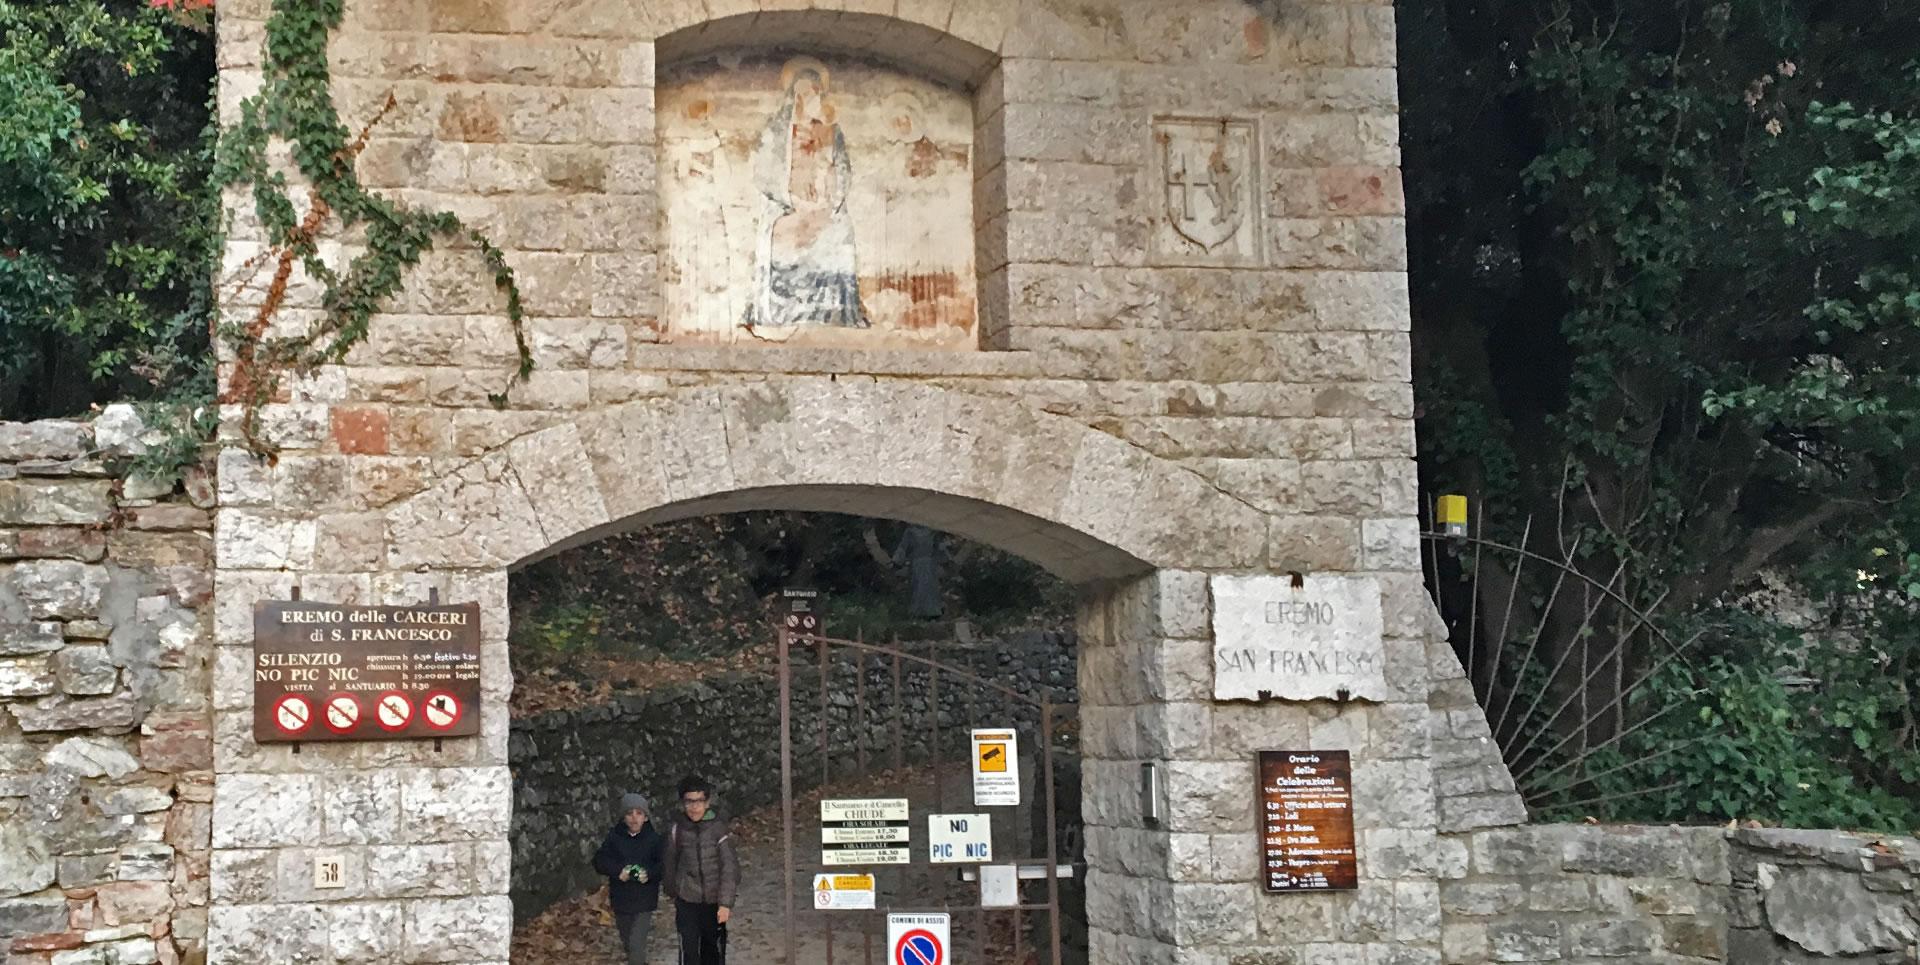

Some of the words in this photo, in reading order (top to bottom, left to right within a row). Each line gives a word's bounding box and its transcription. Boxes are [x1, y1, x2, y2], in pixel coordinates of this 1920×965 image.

[282, 610, 343, 623] EREMO
[350, 610, 386, 623] delle
[393, 611, 467, 625] CARCERI
[1266, 601, 1334, 625] EREMO
[310, 629, 324, 642] di
[331, 629, 345, 641] S.
[352, 629, 452, 641] FRANCESCO
[434, 652, 460, 662] festivo
[1219, 649, 1256, 673] SAN
[1270, 650, 1382, 676] FRANCESCO
[256, 669, 282, 682] NO
[291, 669, 319, 681] PIC
[328, 668, 359, 681] NIC
[345, 682, 396, 690] SANTUARIO
[1289, 755, 1320, 763] Orario
[1294, 766, 1316, 774] delle
[1277, 776, 1334, 786] Celebrazioni
[845, 809, 885, 819] CHIUDE
[950, 819, 968, 832] NO
[933, 844, 952, 857] PIC
[966, 843, 987, 856] NIC
